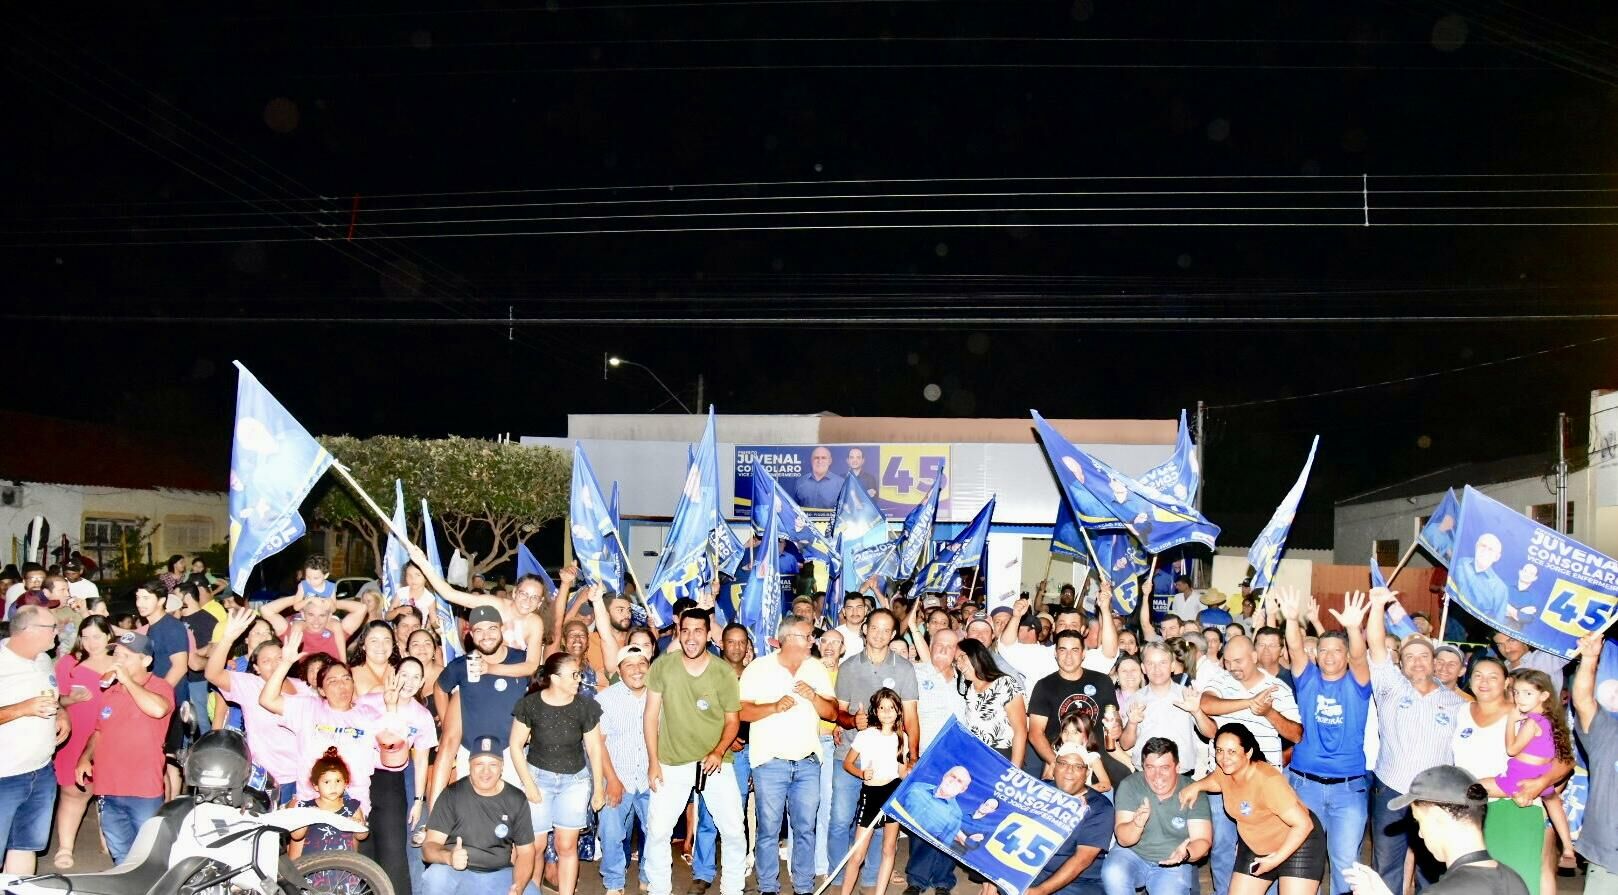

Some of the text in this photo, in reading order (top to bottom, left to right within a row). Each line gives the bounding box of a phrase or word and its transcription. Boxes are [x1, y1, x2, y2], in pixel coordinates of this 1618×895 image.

[737, 453, 801, 464] JUVENAL
[882, 456, 948, 493] 45
[1547, 590, 1612, 632] 45
[994, 821, 1057, 867] 45
